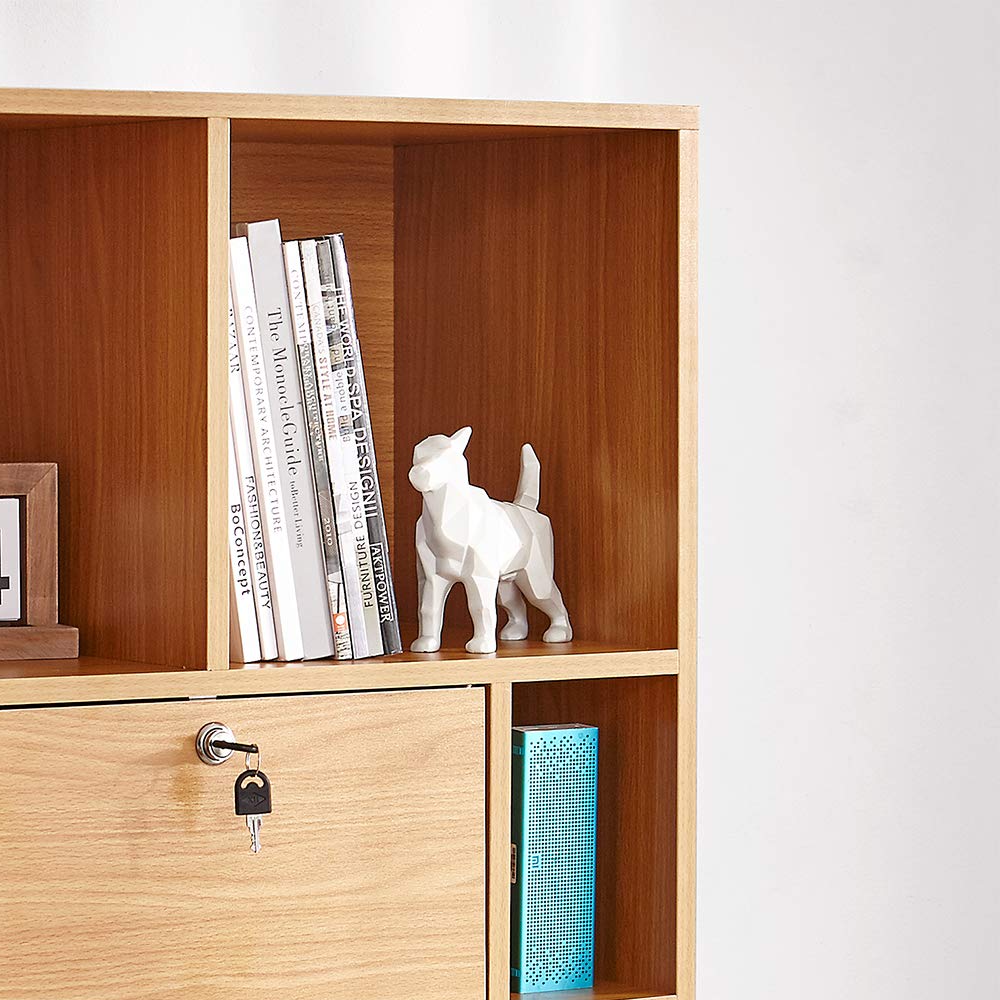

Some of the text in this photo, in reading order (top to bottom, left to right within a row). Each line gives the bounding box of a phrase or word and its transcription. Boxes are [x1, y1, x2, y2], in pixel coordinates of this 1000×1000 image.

[319, 356, 332, 391] STYLE
[323, 394, 333, 407] AT
[340, 319, 357, 377] WORLD
[349, 383, 364, 421] SPA
[245, 305, 282, 533] CONTEMPORARY ARCHITECTURE
[267, 307, 283, 342] The
[294, 518, 304, 549] Living
[326, 409, 337, 441] HOME
[231, 503, 251, 596] BoConcept
[245, 475, 271, 610] FASHION&BEAUTY
[324, 517, 333, 546] 2010
[349, 481, 373, 608] FURNITURE DESIGN
